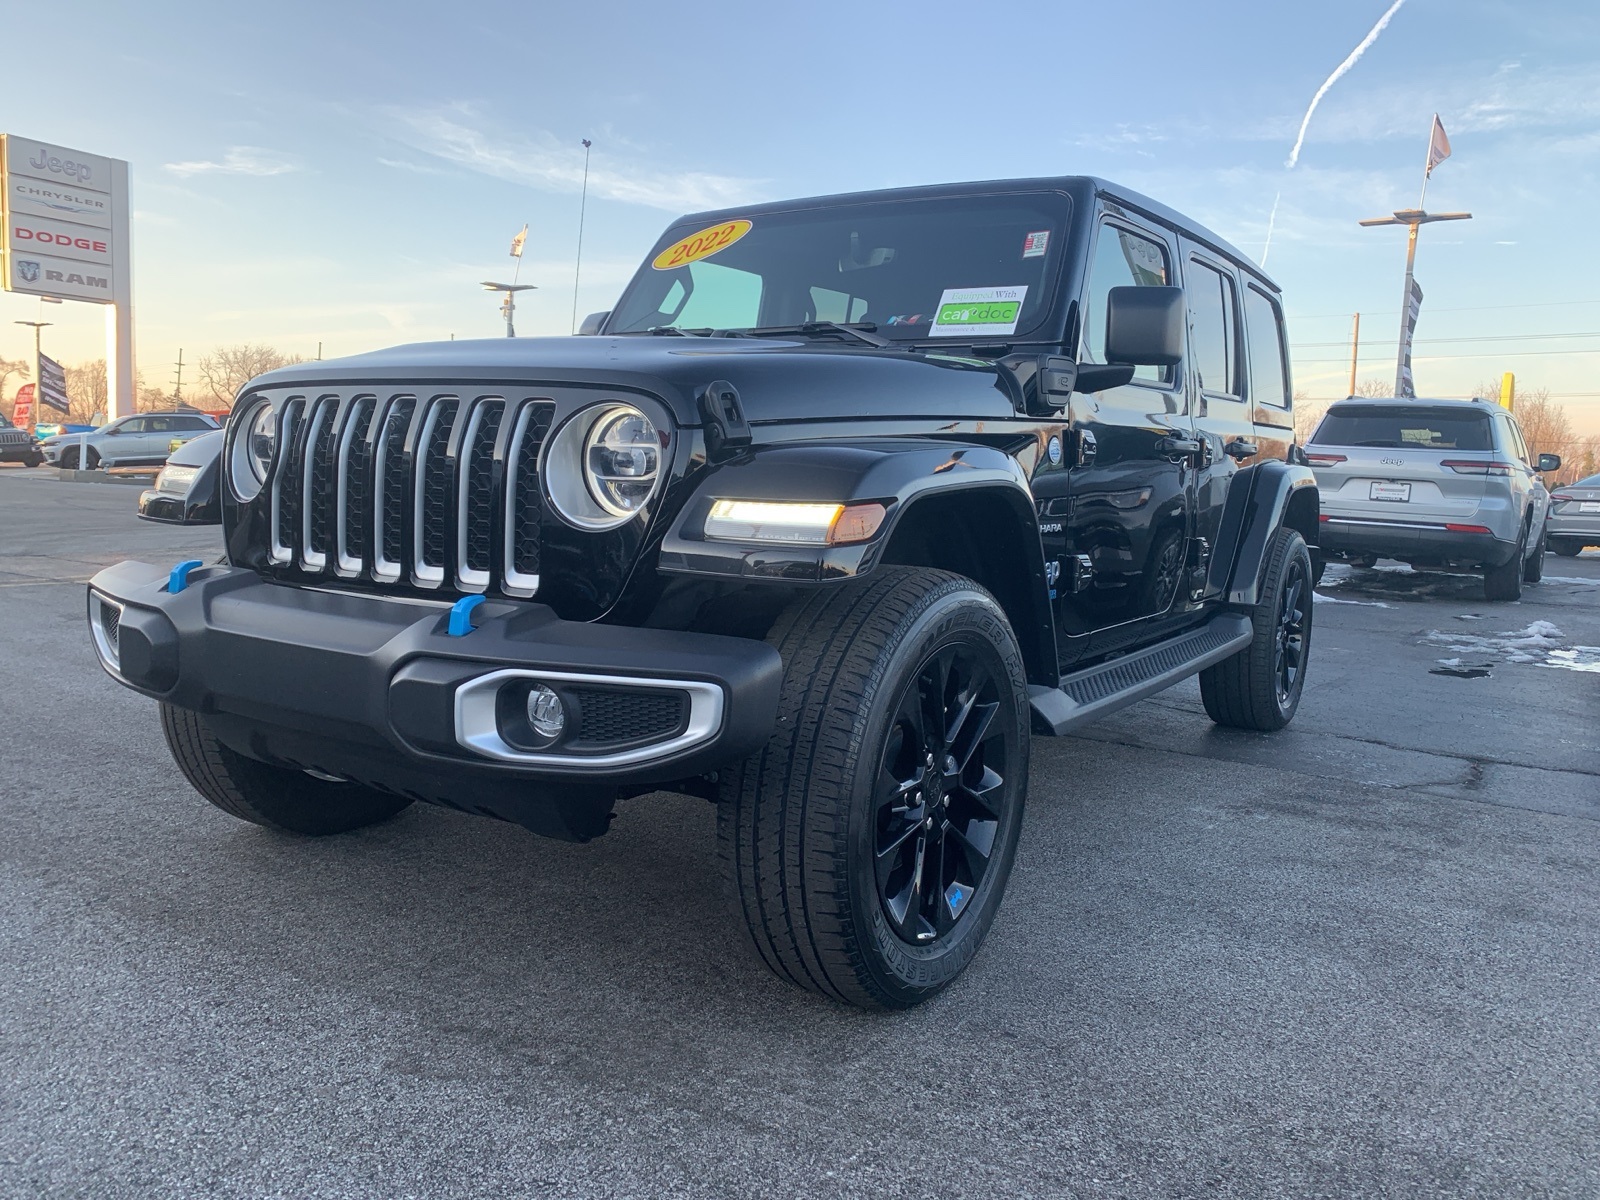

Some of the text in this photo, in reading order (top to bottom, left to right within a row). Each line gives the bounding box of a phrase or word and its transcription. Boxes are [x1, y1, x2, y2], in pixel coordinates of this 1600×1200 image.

[29, 149, 92, 182] Jeep
[16, 185, 104, 208] CHRYSLER
[15, 227, 107, 253] DODGE
[668, 225, 736, 265] 2022
[45, 269, 108, 289] RAM
[952, 292, 993, 300] Equipped
[1380, 456, 1405, 466] Jeep
[1040, 524, 1062, 533] HARA
